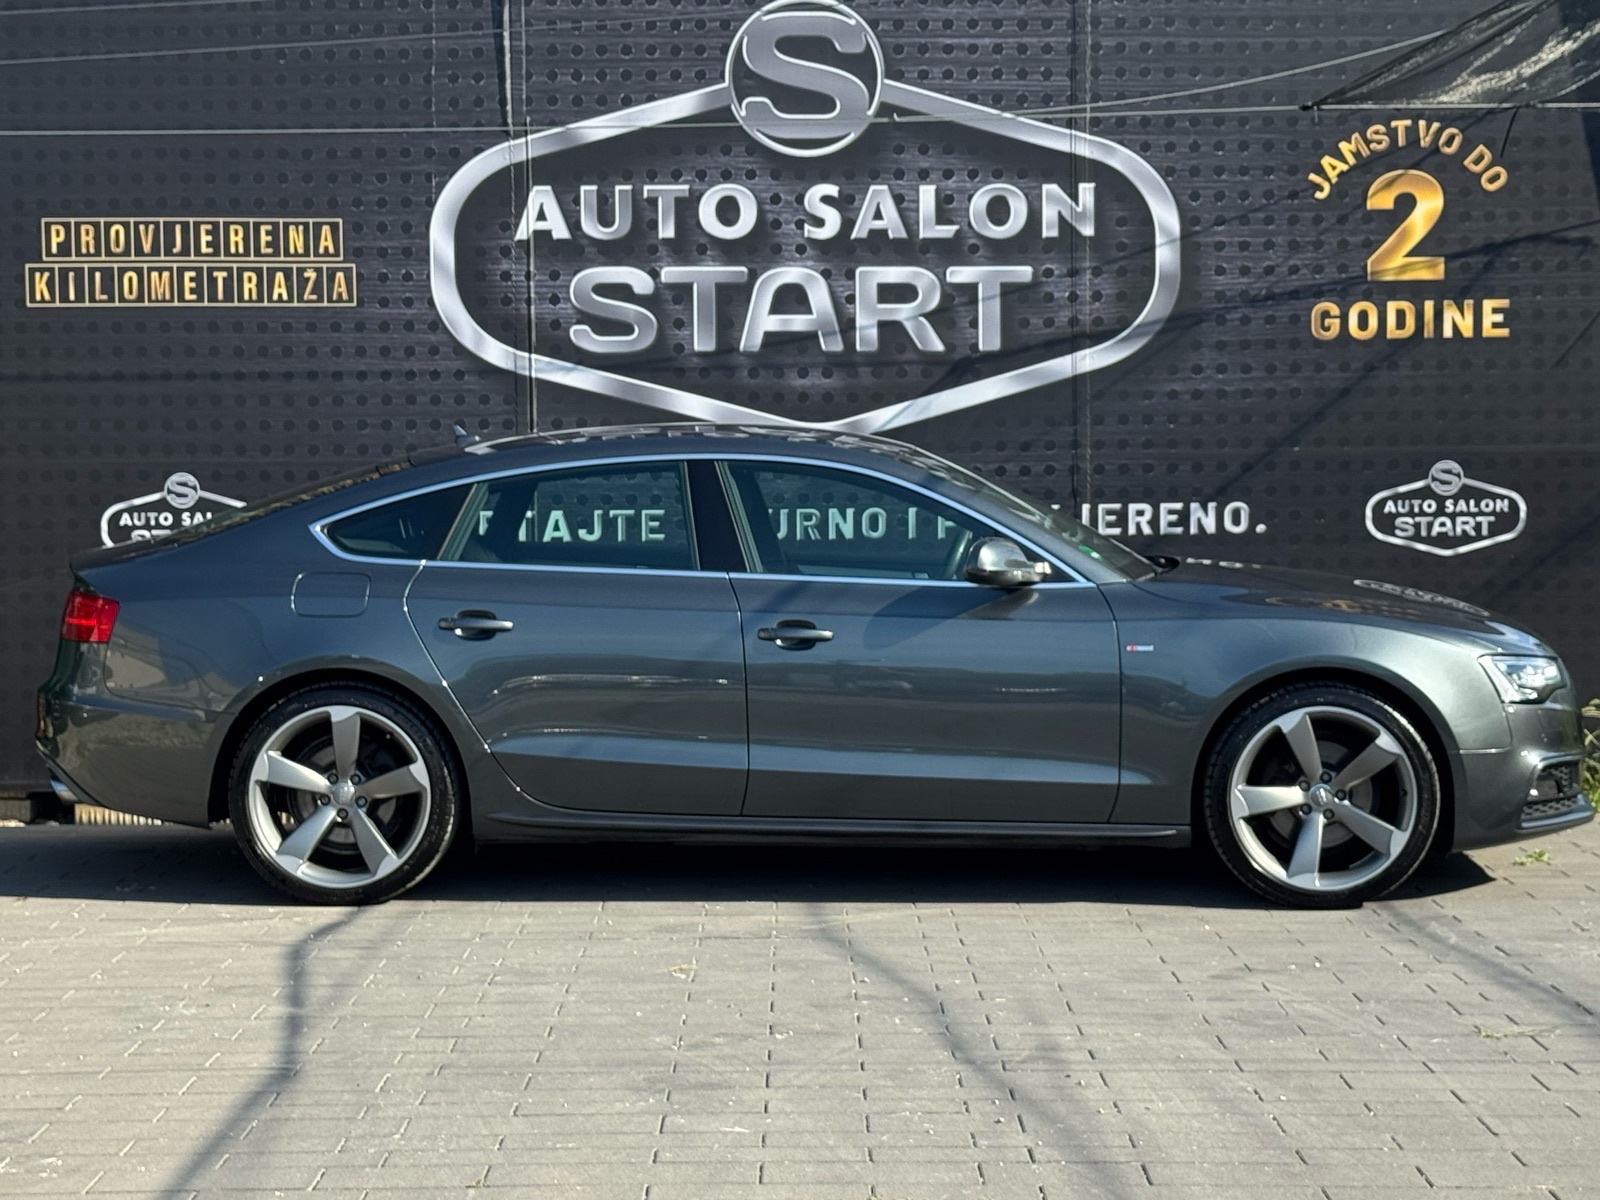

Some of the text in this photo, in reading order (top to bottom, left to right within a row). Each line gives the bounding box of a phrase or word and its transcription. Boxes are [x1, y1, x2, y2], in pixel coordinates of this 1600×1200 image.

[1307, 119, 1509, 200] JAMSTVO DO
[514, 182, 1097, 241] AUTO SALON
[1366, 169, 1445, 282] 2
[49, 223, 336, 255] PROVJERENA
[34, 267, 349, 301] KILOMETRAŽA
[569, 265, 1034, 354] START
[1310, 298, 1511, 341] GODINE
[118, 511, 174, 527] AUTO
[1383, 498, 1510, 514] AUTO SALON
[1394, 515, 1497, 537] START
